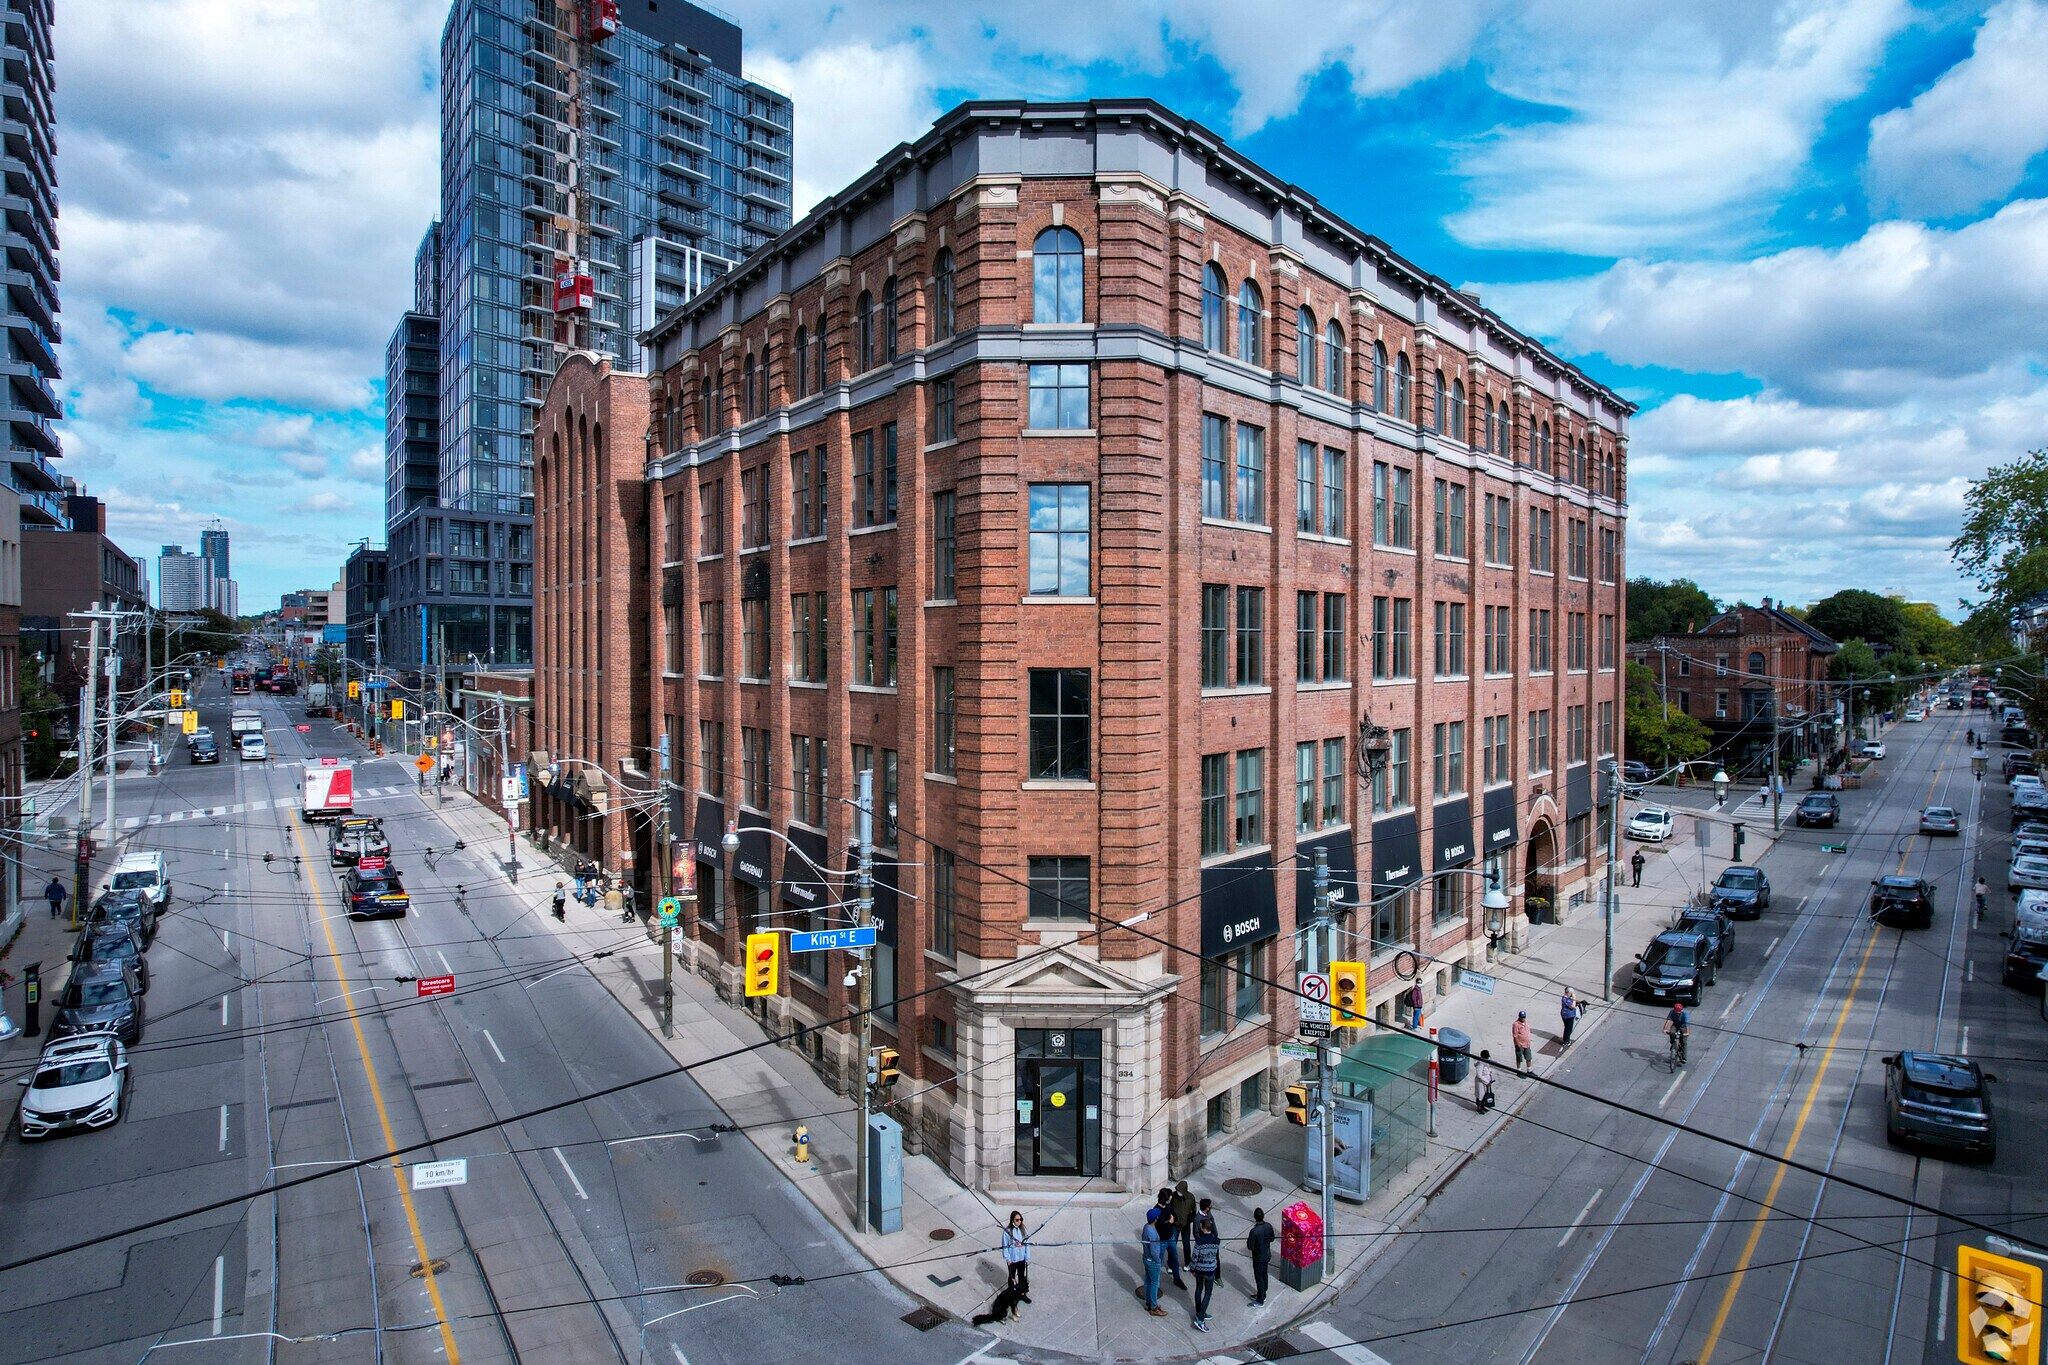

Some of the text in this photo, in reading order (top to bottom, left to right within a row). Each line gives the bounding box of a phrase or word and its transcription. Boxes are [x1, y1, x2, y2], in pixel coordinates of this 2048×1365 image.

[703, 845, 717, 859] BOSCH
[1450, 844, 1465, 858] BOSCH
[739, 860, 763, 878] GAGGENAU
[1385, 865, 1410, 881] Thermador
[790, 882, 816, 902] Thermador
[1234, 917, 1260, 937] BOSCH
[811, 933, 837, 947] King
[849, 931, 856, 942] E
[1304, 1029, 1326, 1037] EXCEPTED
[1309, 1022, 1330, 1030] VEHICLES
[425, 1169, 454, 1178] 10 km/hr
